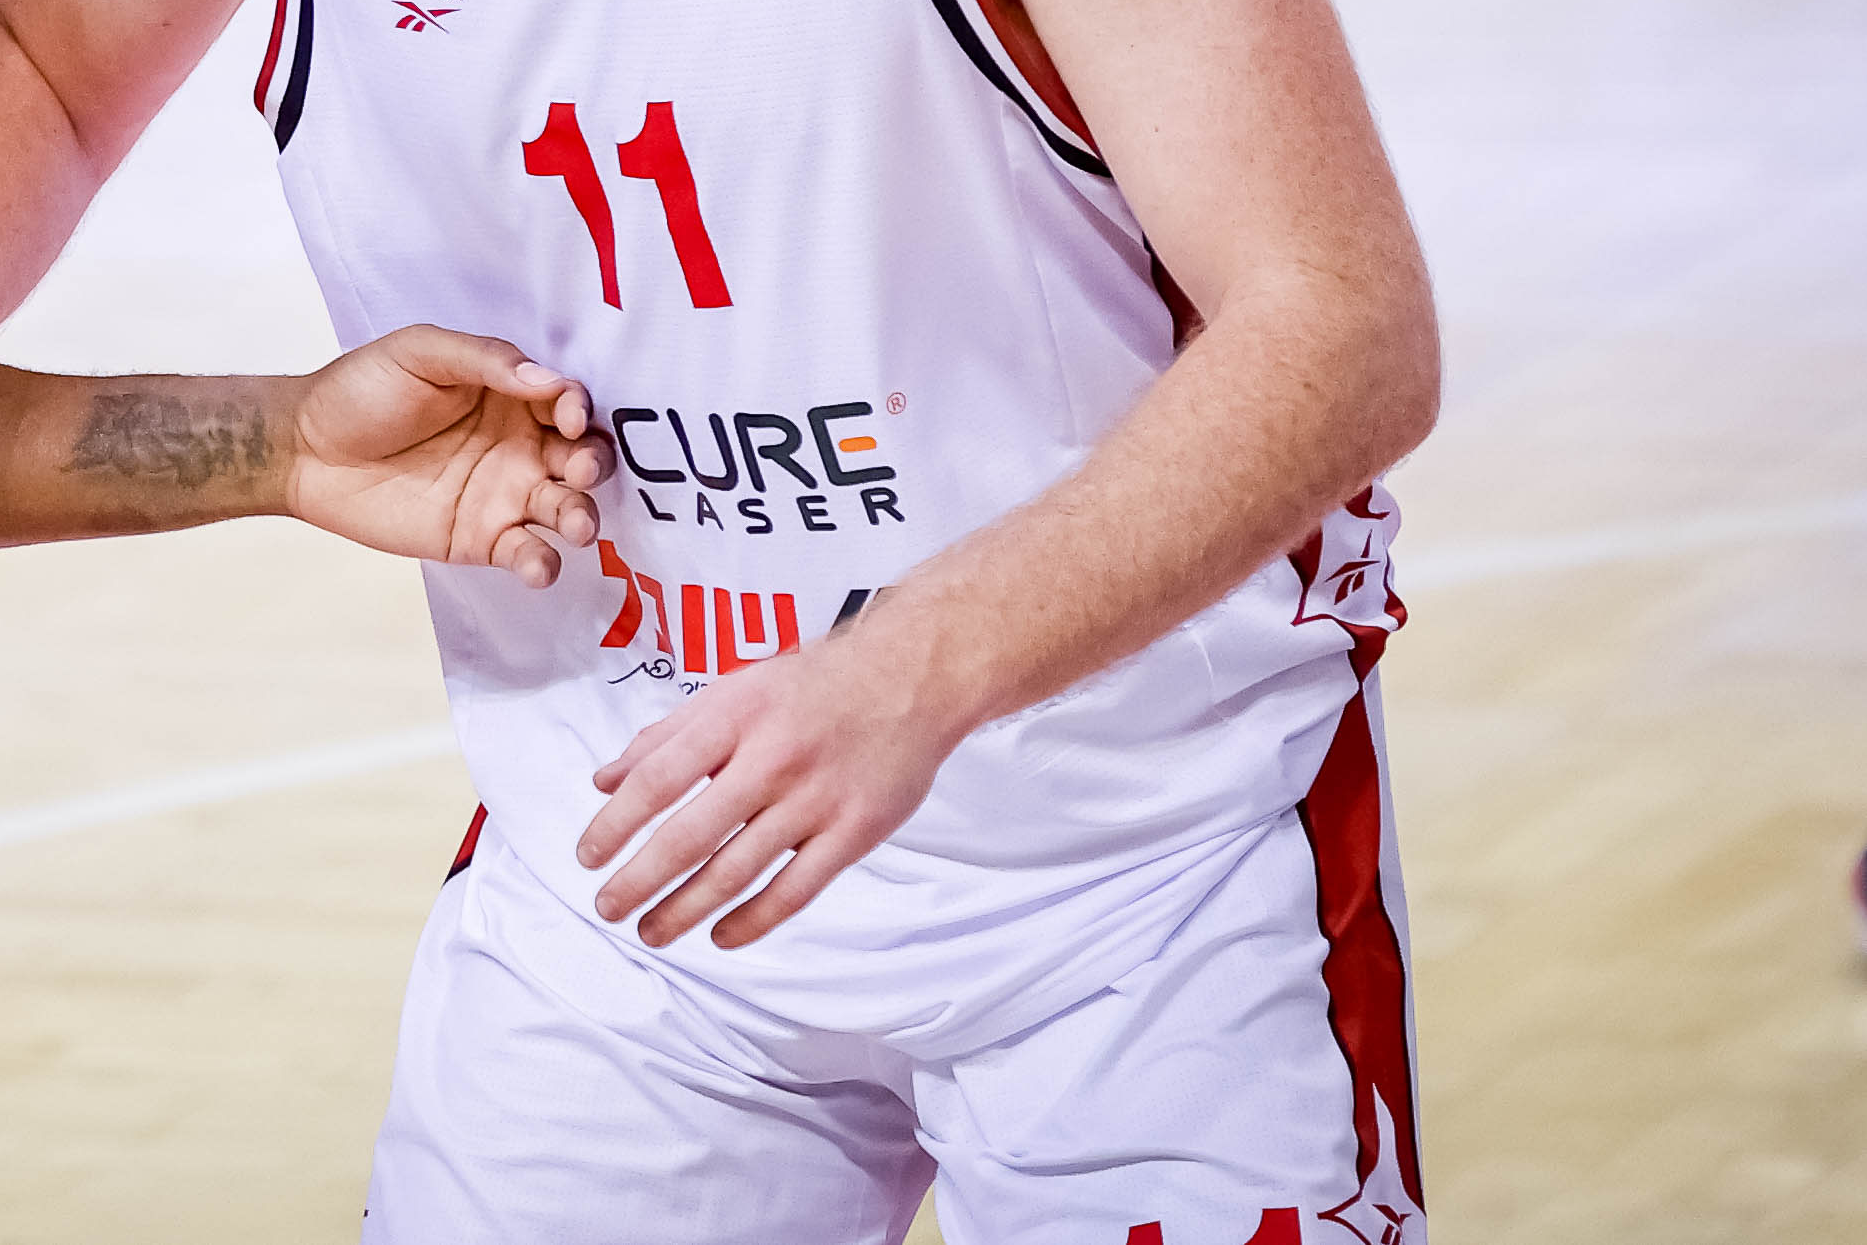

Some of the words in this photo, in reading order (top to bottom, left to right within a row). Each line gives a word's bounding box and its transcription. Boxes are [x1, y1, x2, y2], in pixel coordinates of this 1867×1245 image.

[521, 101, 734, 311] 11
[612, 402, 896, 493] CURE
[637, 487, 905, 534] LASER
